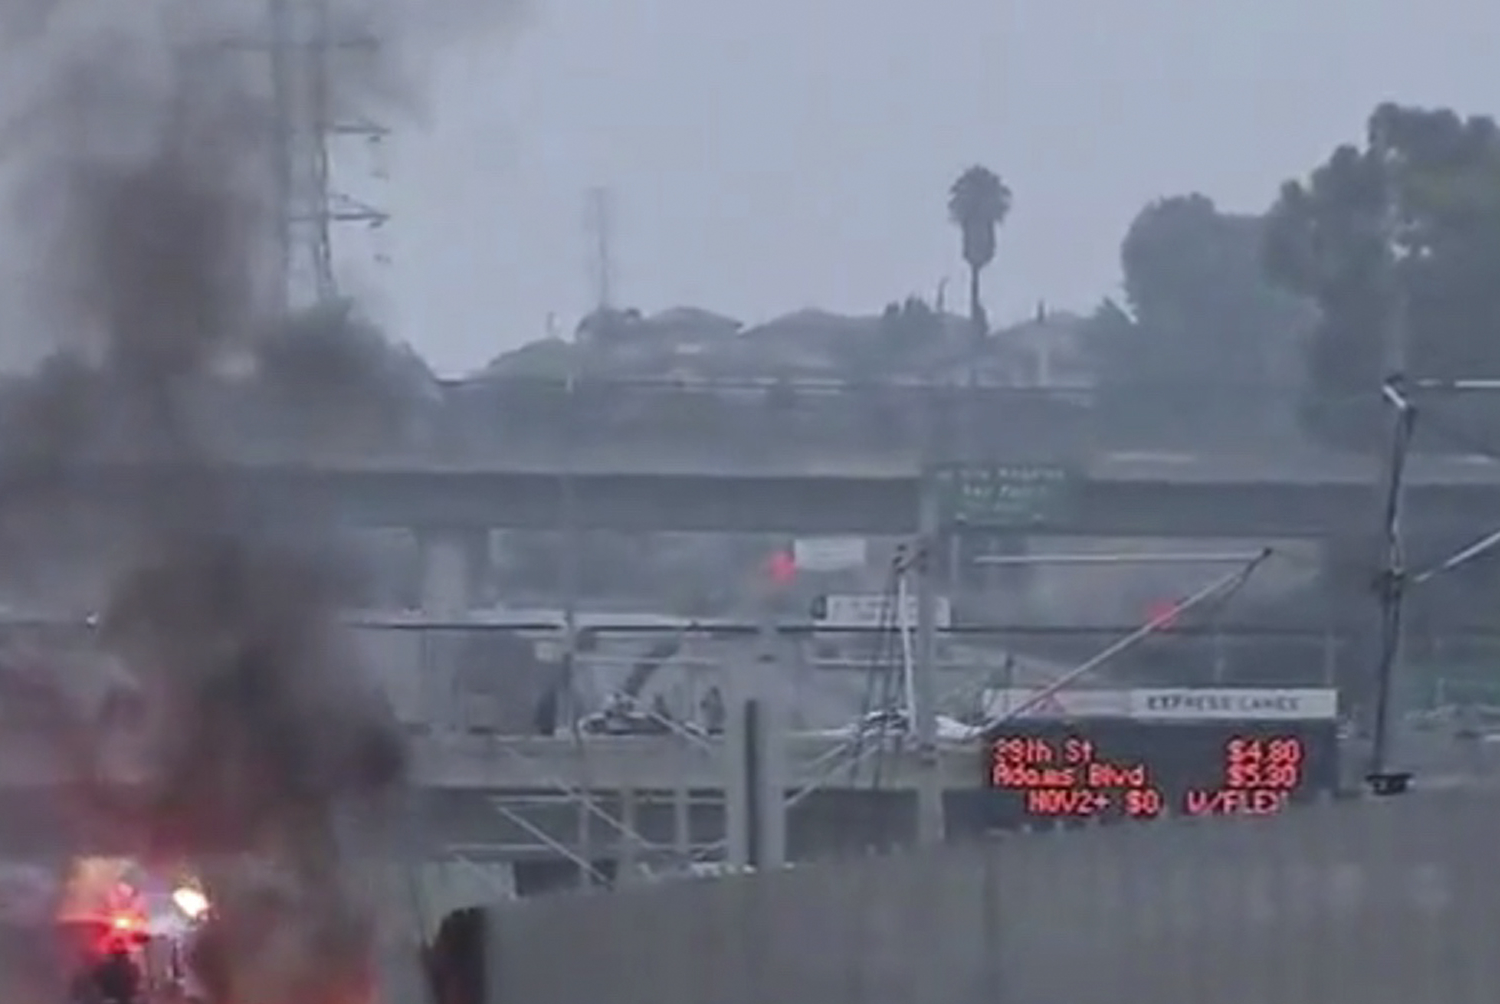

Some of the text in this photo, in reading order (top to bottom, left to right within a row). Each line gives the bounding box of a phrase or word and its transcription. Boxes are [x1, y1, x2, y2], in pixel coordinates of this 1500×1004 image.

[1065, 739, 1093, 762] St
[992, 763, 1146, 787] Adams Blvd
